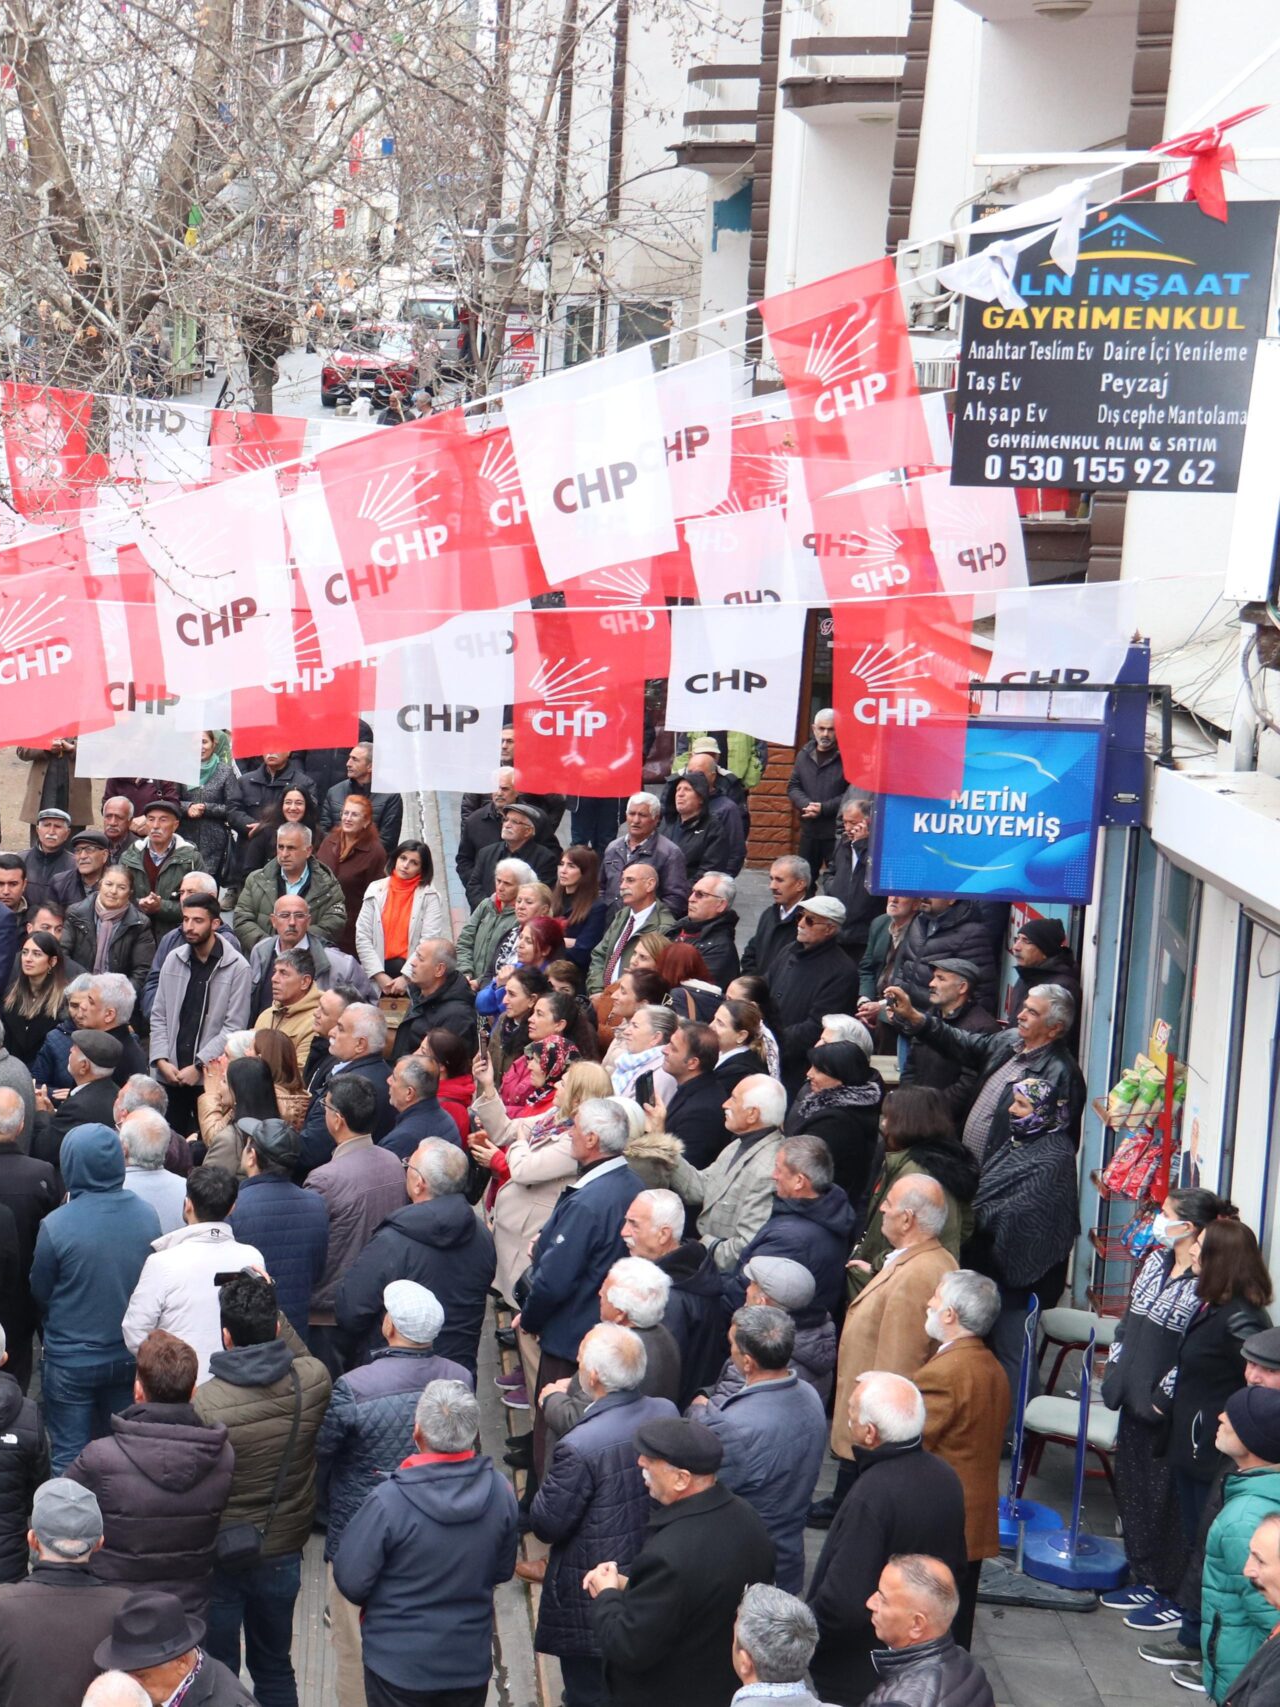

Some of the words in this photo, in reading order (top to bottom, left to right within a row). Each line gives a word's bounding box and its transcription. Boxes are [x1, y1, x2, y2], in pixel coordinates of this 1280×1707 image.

[1018, 272, 1073, 296] LN
[1088, 267, 1250, 301] İNŞAAT
[982, 301, 1246, 330] GAYRİMENKUL
[968, 341, 1026, 361] Anahtar
[1029, 339, 1073, 361] Teslim
[1076, 341, 1094, 361] Ev
[1103, 341, 1146, 361] Daire
[1149, 337, 1170, 365] İçi
[1174, 342, 1248, 362] Yenileme
[966, 372, 995, 393] Taş
[1000, 373, 1022, 391] Ev
[1100, 373, 1170, 399] Peyzaj
[813, 373, 888, 422] CHP
[963, 403, 1021, 424] Ahşap
[1026, 404, 1048, 423] Ev
[1097, 405, 1120, 428] Dış
[1122, 406, 1165, 430] cephe
[1168, 405, 1248, 425] Mantolama
[987, 431, 1100, 450] GAYRİMENKUL
[1104, 436, 1144, 451] ALIM
[1149, 437, 1162, 451] &
[1167, 437, 1218, 452] SATIM
[984, 455, 1003, 481] 0
[1009, 455, 1064, 482] 530
[1073, 456, 1126, 484] 155
[1133, 457, 1170, 485] 92
[1177, 459, 1216, 486] 62
[552, 461, 638, 514] CHP
[370, 524, 450, 567] CHP
[176, 596, 258, 647] CHP
[262, 667, 335, 694] CHP
[684, 668, 768, 694] CHP
[397, 704, 480, 733] CHP
[531, 710, 608, 738] CHP
[852, 697, 932, 727] CHP
[948, 785, 1027, 812] METİN
[913, 811, 1062, 843] KURUYEMİŞ
